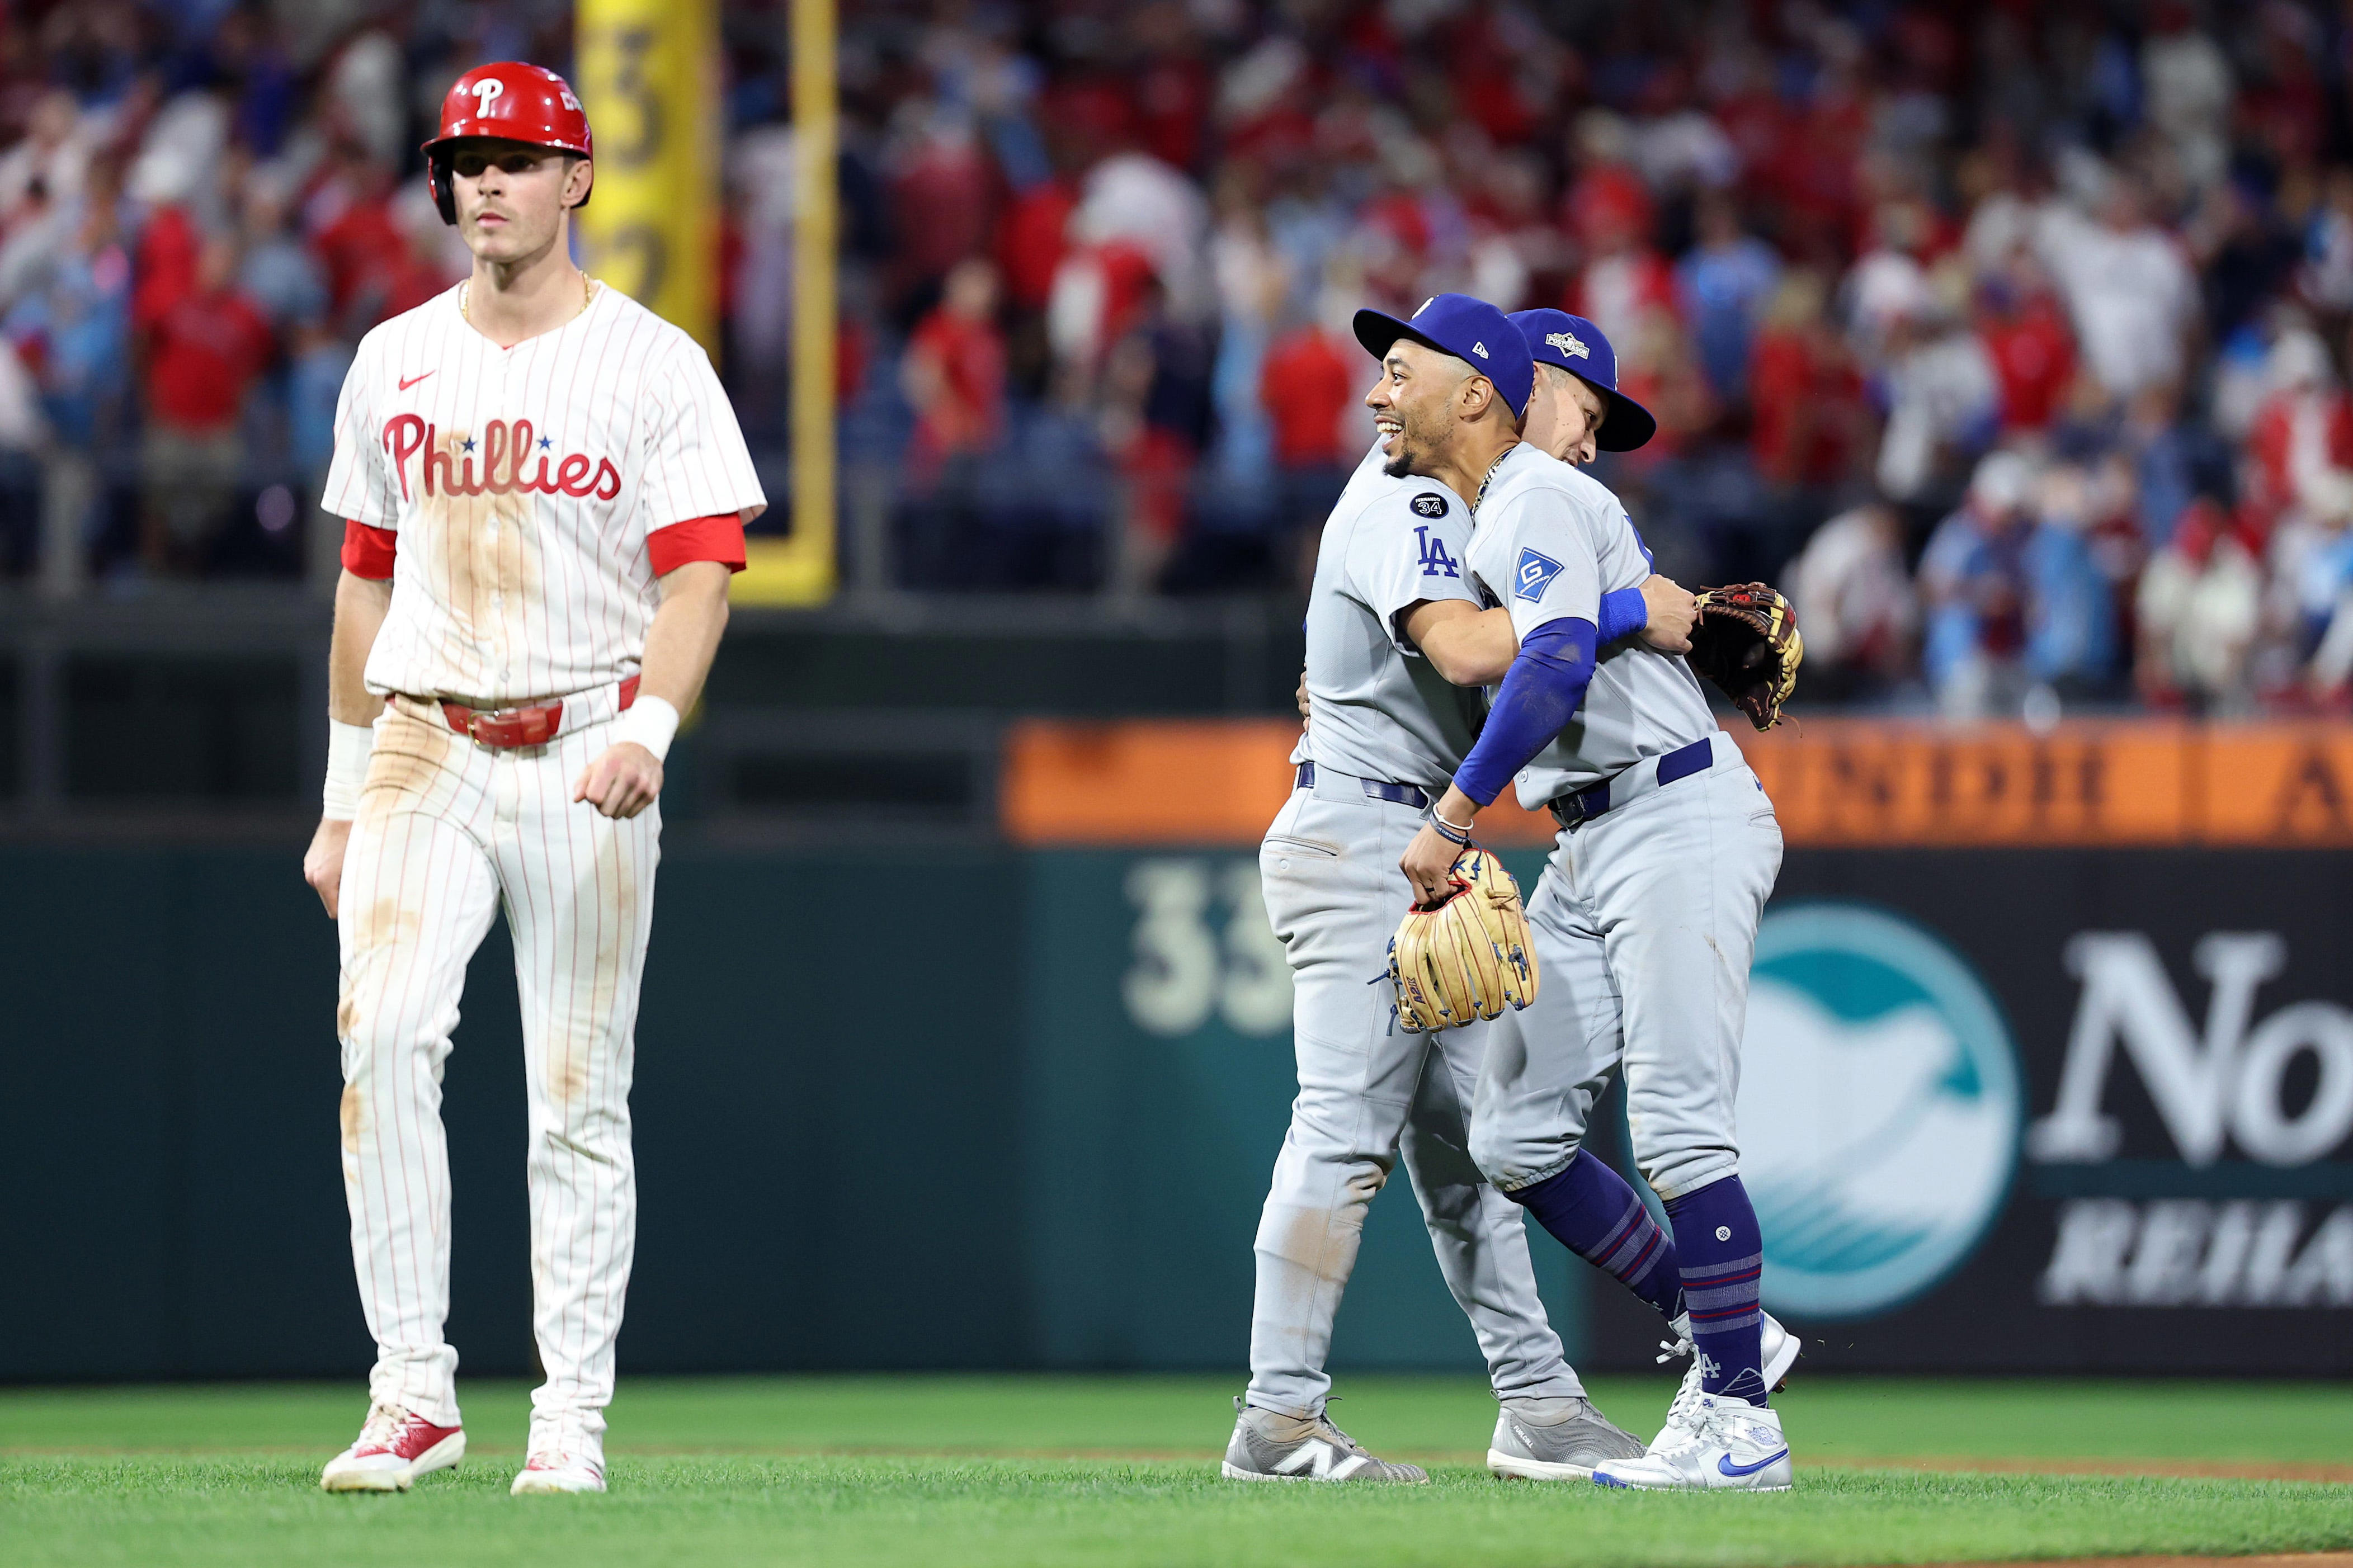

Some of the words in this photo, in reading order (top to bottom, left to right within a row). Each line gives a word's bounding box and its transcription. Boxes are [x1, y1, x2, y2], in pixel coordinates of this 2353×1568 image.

[472, 78, 504, 119] P
[383, 413, 621, 503] Phillies
[1417, 501, 1442, 514] 34
[1413, 526, 1460, 578] LA
